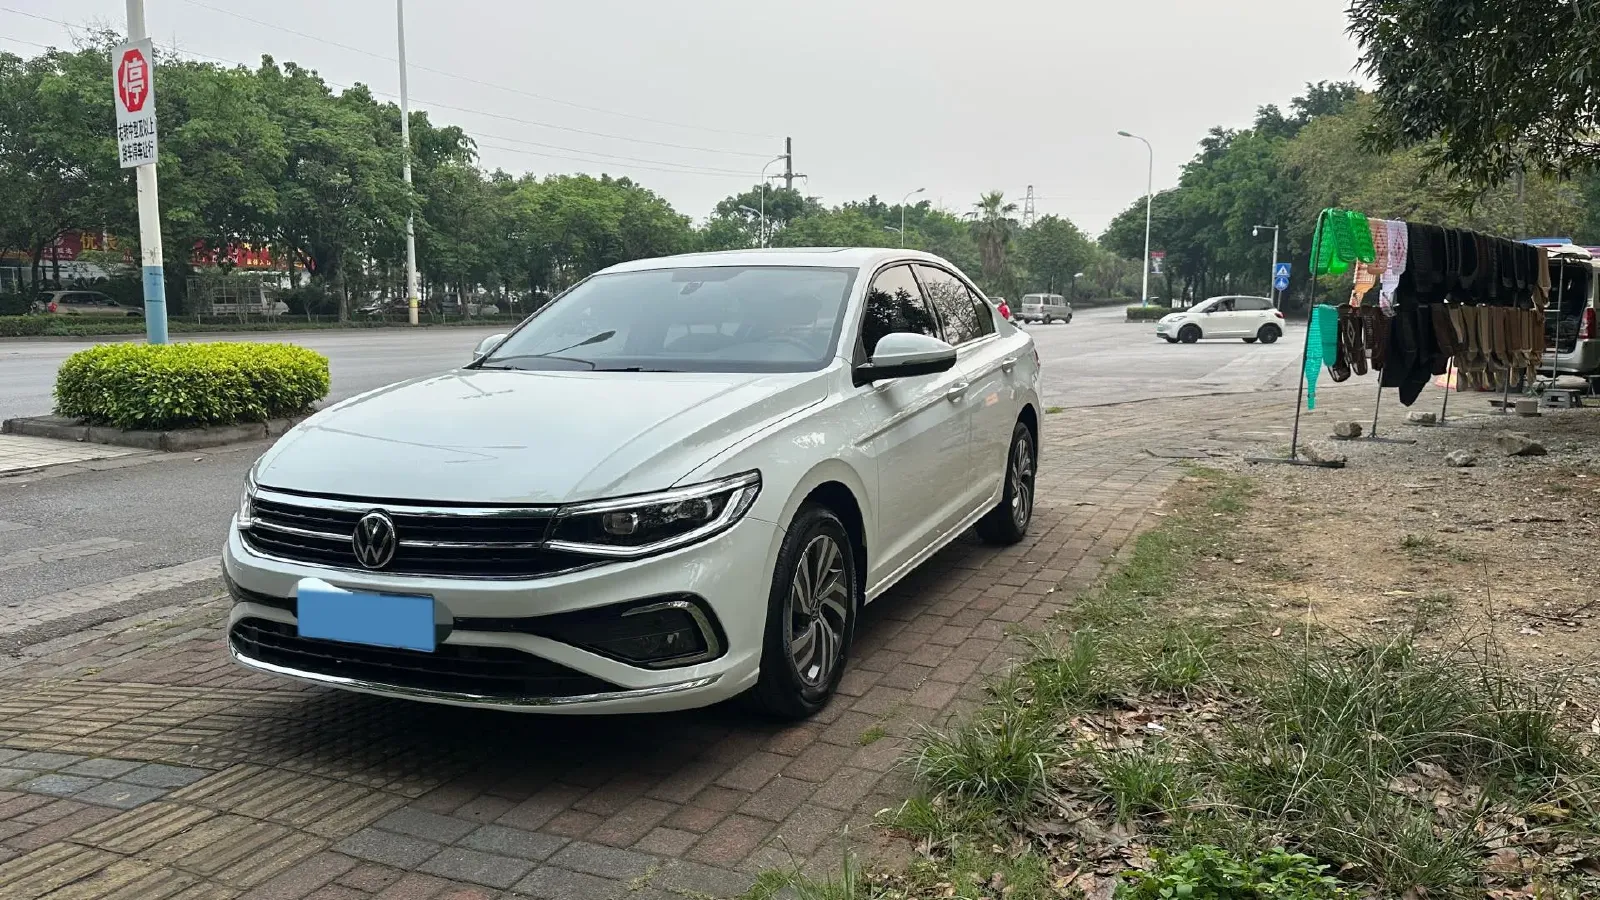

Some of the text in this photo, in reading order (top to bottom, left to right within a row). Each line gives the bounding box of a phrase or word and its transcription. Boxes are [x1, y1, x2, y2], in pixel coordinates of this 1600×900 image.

[122, 57, 145, 107] 停
[122, 140, 154, 162] 货车停车让行
